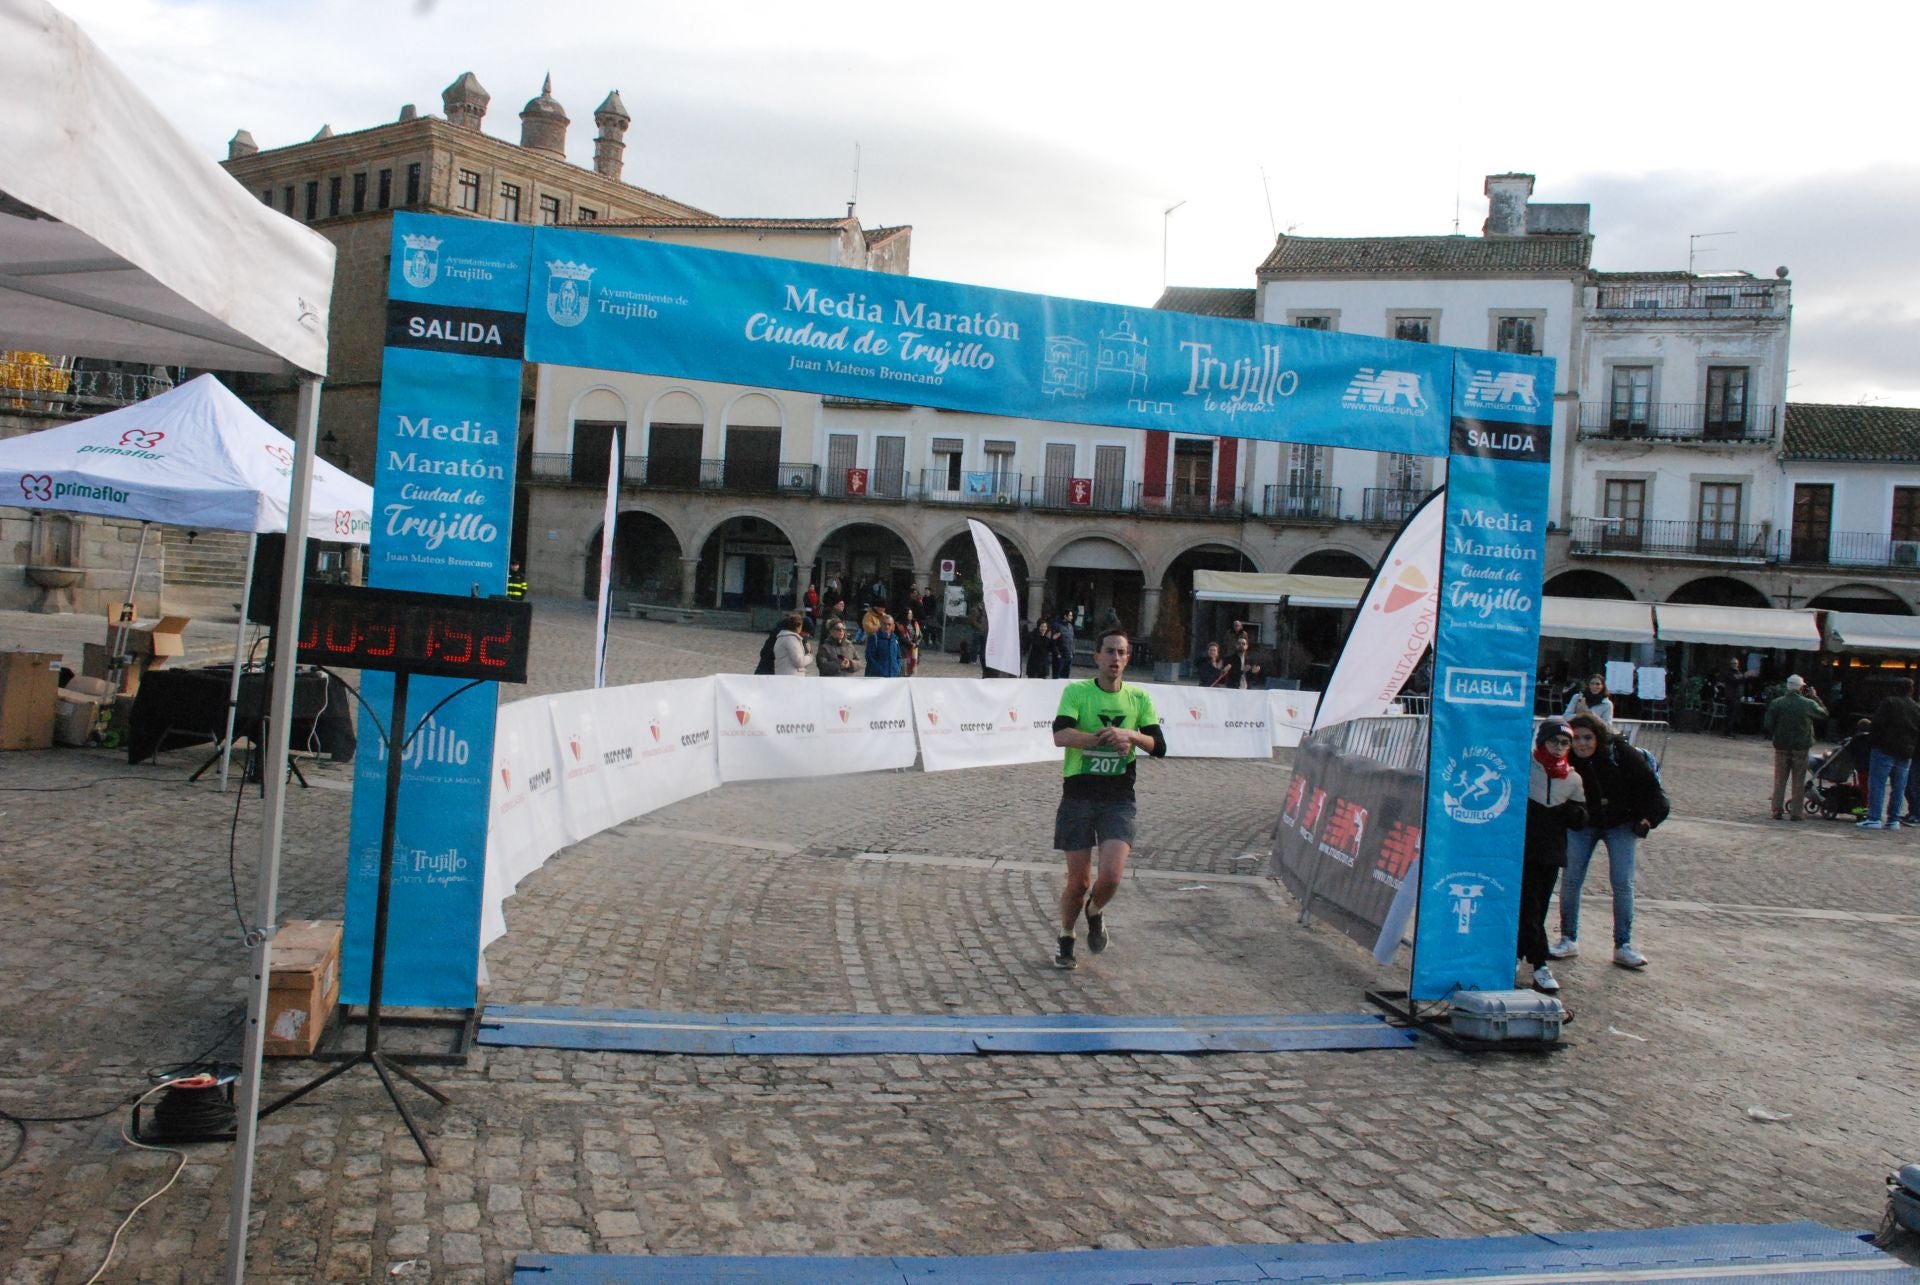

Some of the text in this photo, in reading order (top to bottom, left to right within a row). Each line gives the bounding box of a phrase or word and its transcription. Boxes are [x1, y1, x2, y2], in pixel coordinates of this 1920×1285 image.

[444, 265, 493, 282] Trujillo
[507, 261, 519, 270] de
[600, 286, 689, 306] Ayuntamiento de
[599, 299, 658, 321] Trujillo
[783, 285, 1020, 340] Media Maratón
[408, 316, 502, 345] SALIDA
[745, 312, 995, 374] Ciudad de Trujillo
[788, 355, 943, 386] Juan Mateos Broncano
[1179, 340, 1299, 406] Trujillo
[1204, 392, 1217, 411] te
[1342, 401, 1425, 417] www.musicrun.es
[395, 415, 500, 446] Media
[1468, 430, 1535, 452] SALIDA
[77, 444, 165, 461] primaflor
[386, 450, 504, 480] Maratón
[55, 482, 131, 504] primaflor
[401, 483, 487, 506] Ciudad de
[383, 503, 498, 550] Trujillo
[1459, 508, 1533, 533] Media
[385, 552, 493, 569] Juan Mateos Broncano
[1453, 537, 1538, 561] Maratón
[1461, 563, 1523, 582] Ciudad de
[1449, 581, 1532, 619] Trujillo
[1379, 607, 1436, 702] DIPUTACIÓN
[1456, 678, 1514, 697] HABLA
[1090, 757, 1120, 774] 207
[411, 848, 467, 873] Trujillo
